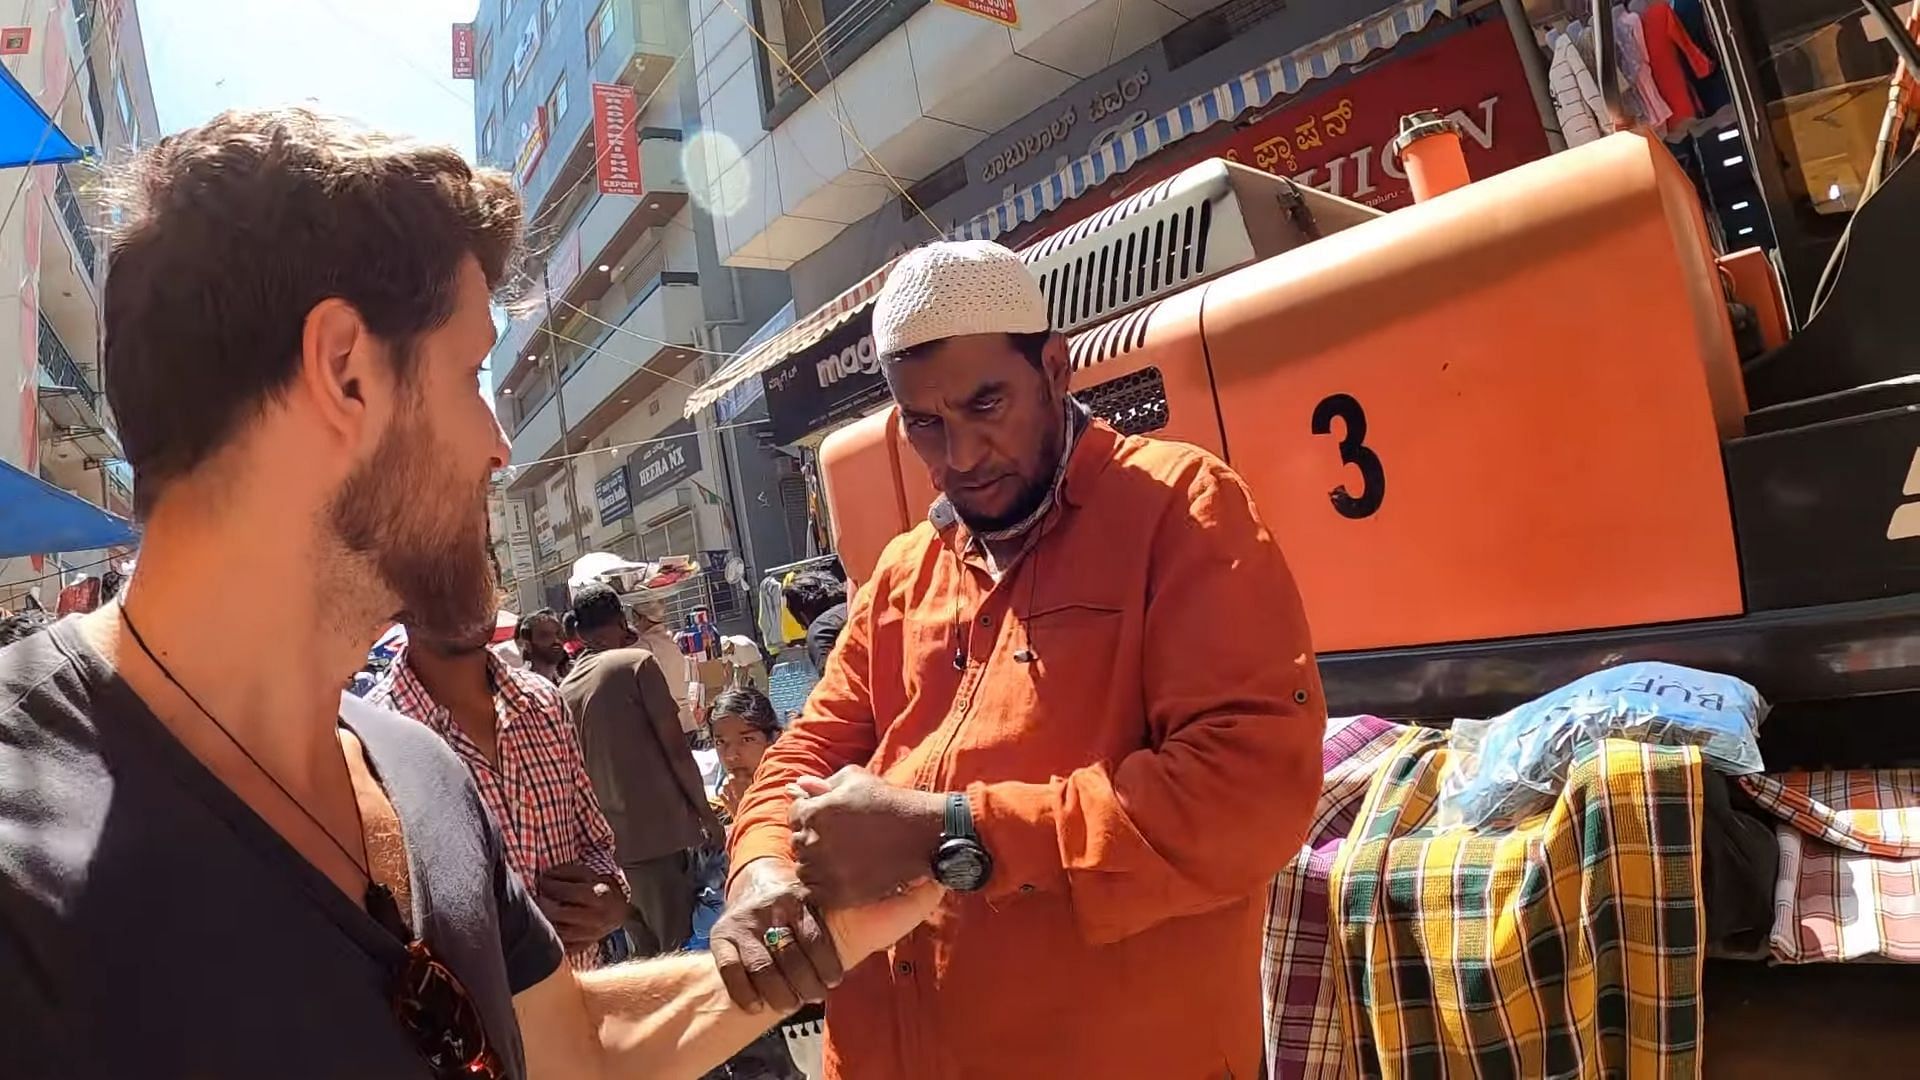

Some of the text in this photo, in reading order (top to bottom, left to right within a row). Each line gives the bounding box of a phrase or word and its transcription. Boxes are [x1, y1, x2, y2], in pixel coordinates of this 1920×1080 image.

[605, 98, 628, 180] RADHAKRISHNA
[603, 180, 639, 189] EXPORT
[639, 457, 669, 487] HEERA
[668, 446, 685, 469] NX
[1311, 393, 1386, 519] 3
